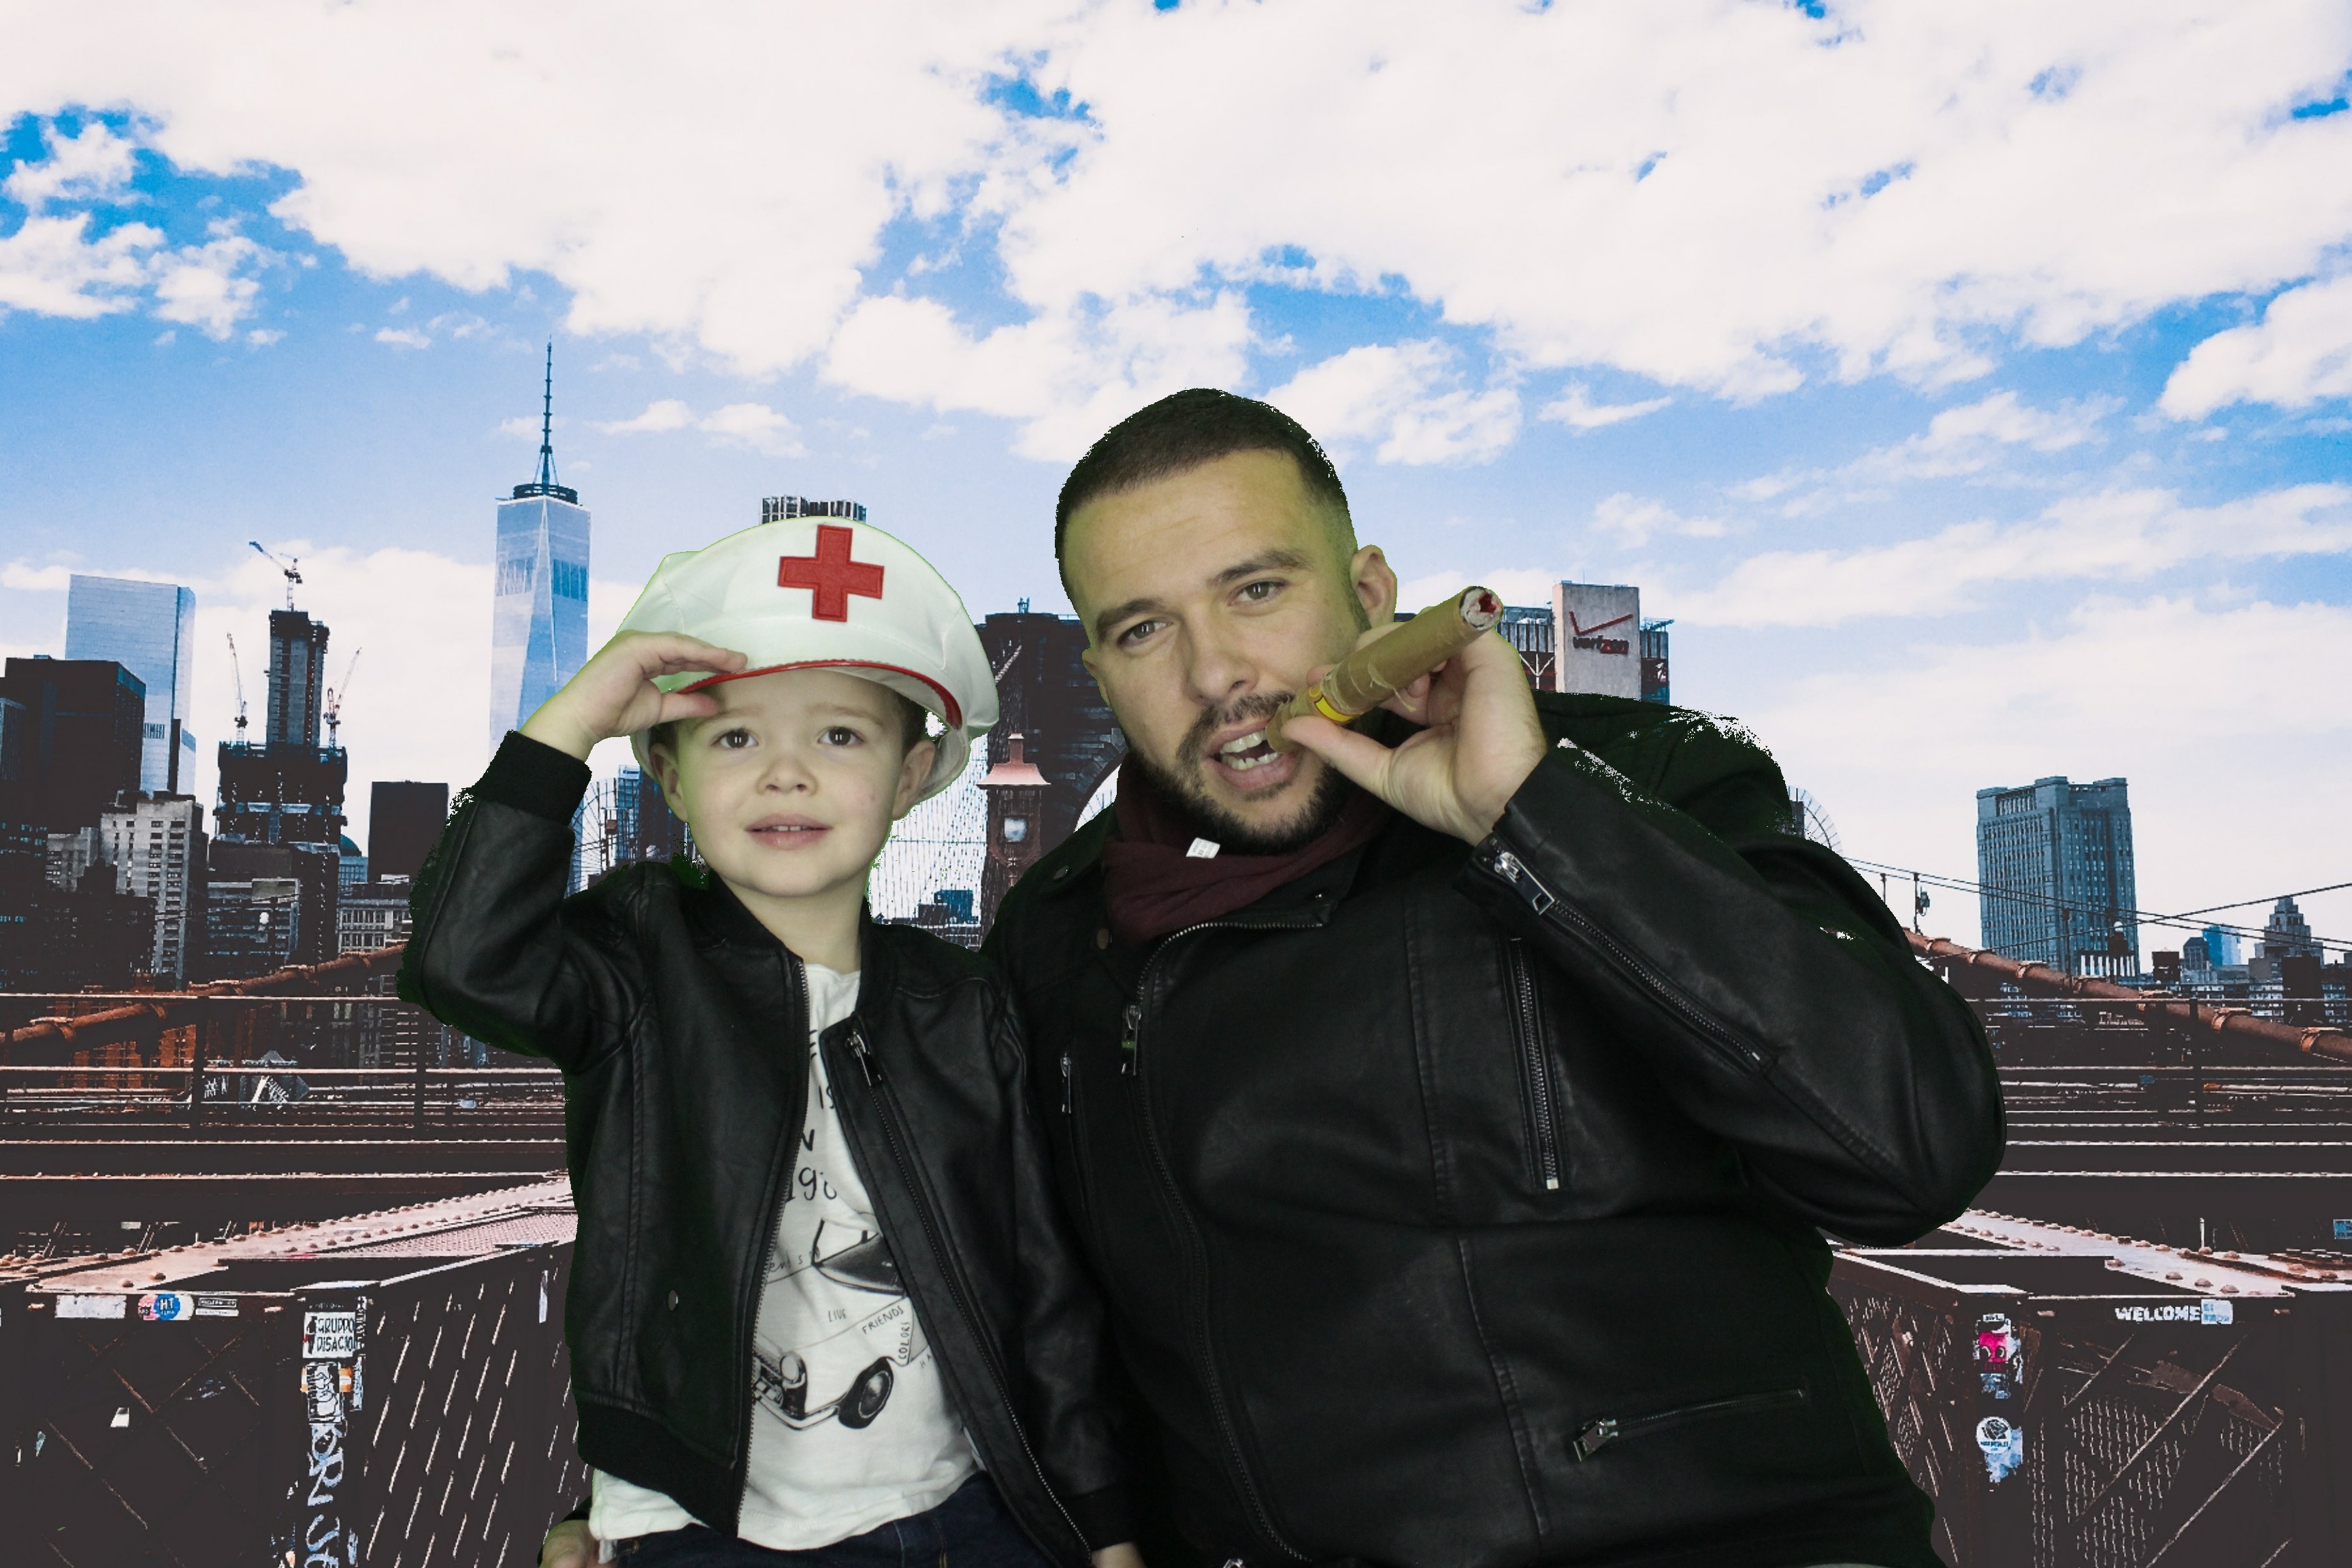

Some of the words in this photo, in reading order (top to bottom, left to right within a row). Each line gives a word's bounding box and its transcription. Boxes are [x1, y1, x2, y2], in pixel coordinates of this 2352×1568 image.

[828, 1309, 847, 1322] LIVE
[862, 1305, 904, 1335] FRIENDS
[2114, 1305, 2201, 1322] WELCOME
[898, 1322, 911, 1360] COLORS
